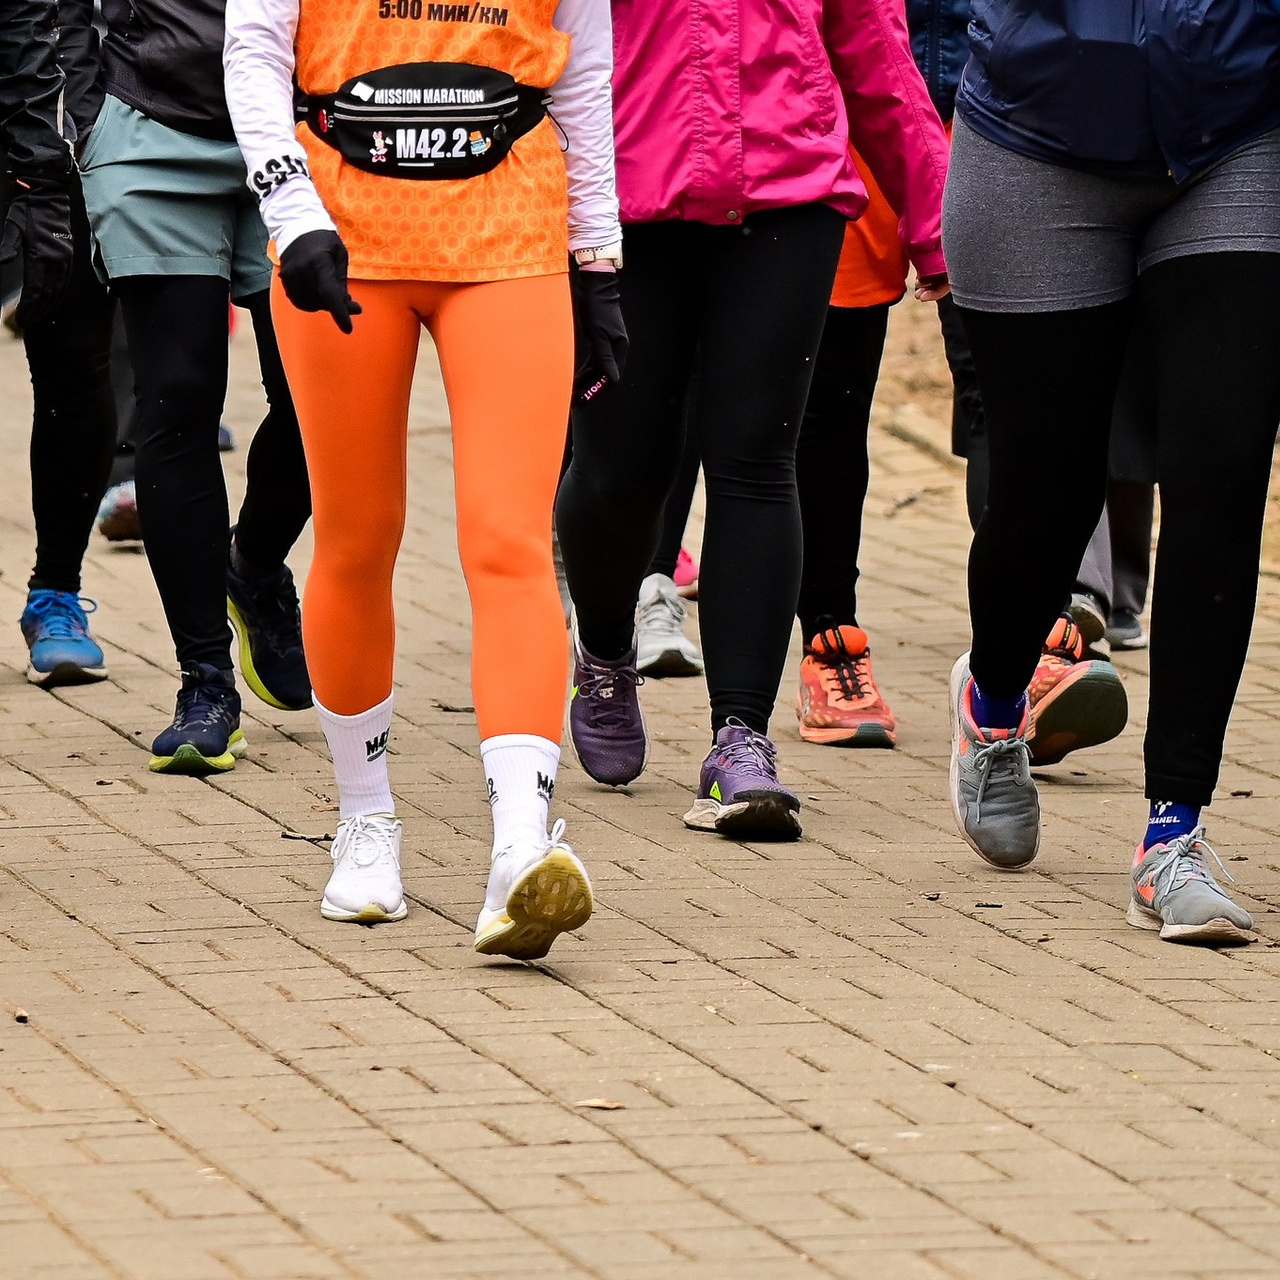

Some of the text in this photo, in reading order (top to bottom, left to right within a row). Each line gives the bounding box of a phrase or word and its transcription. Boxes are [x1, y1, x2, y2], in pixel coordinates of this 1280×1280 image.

[374, 87, 486, 105] MISSION MARATHON
[395, 127, 469, 159] M42.2
